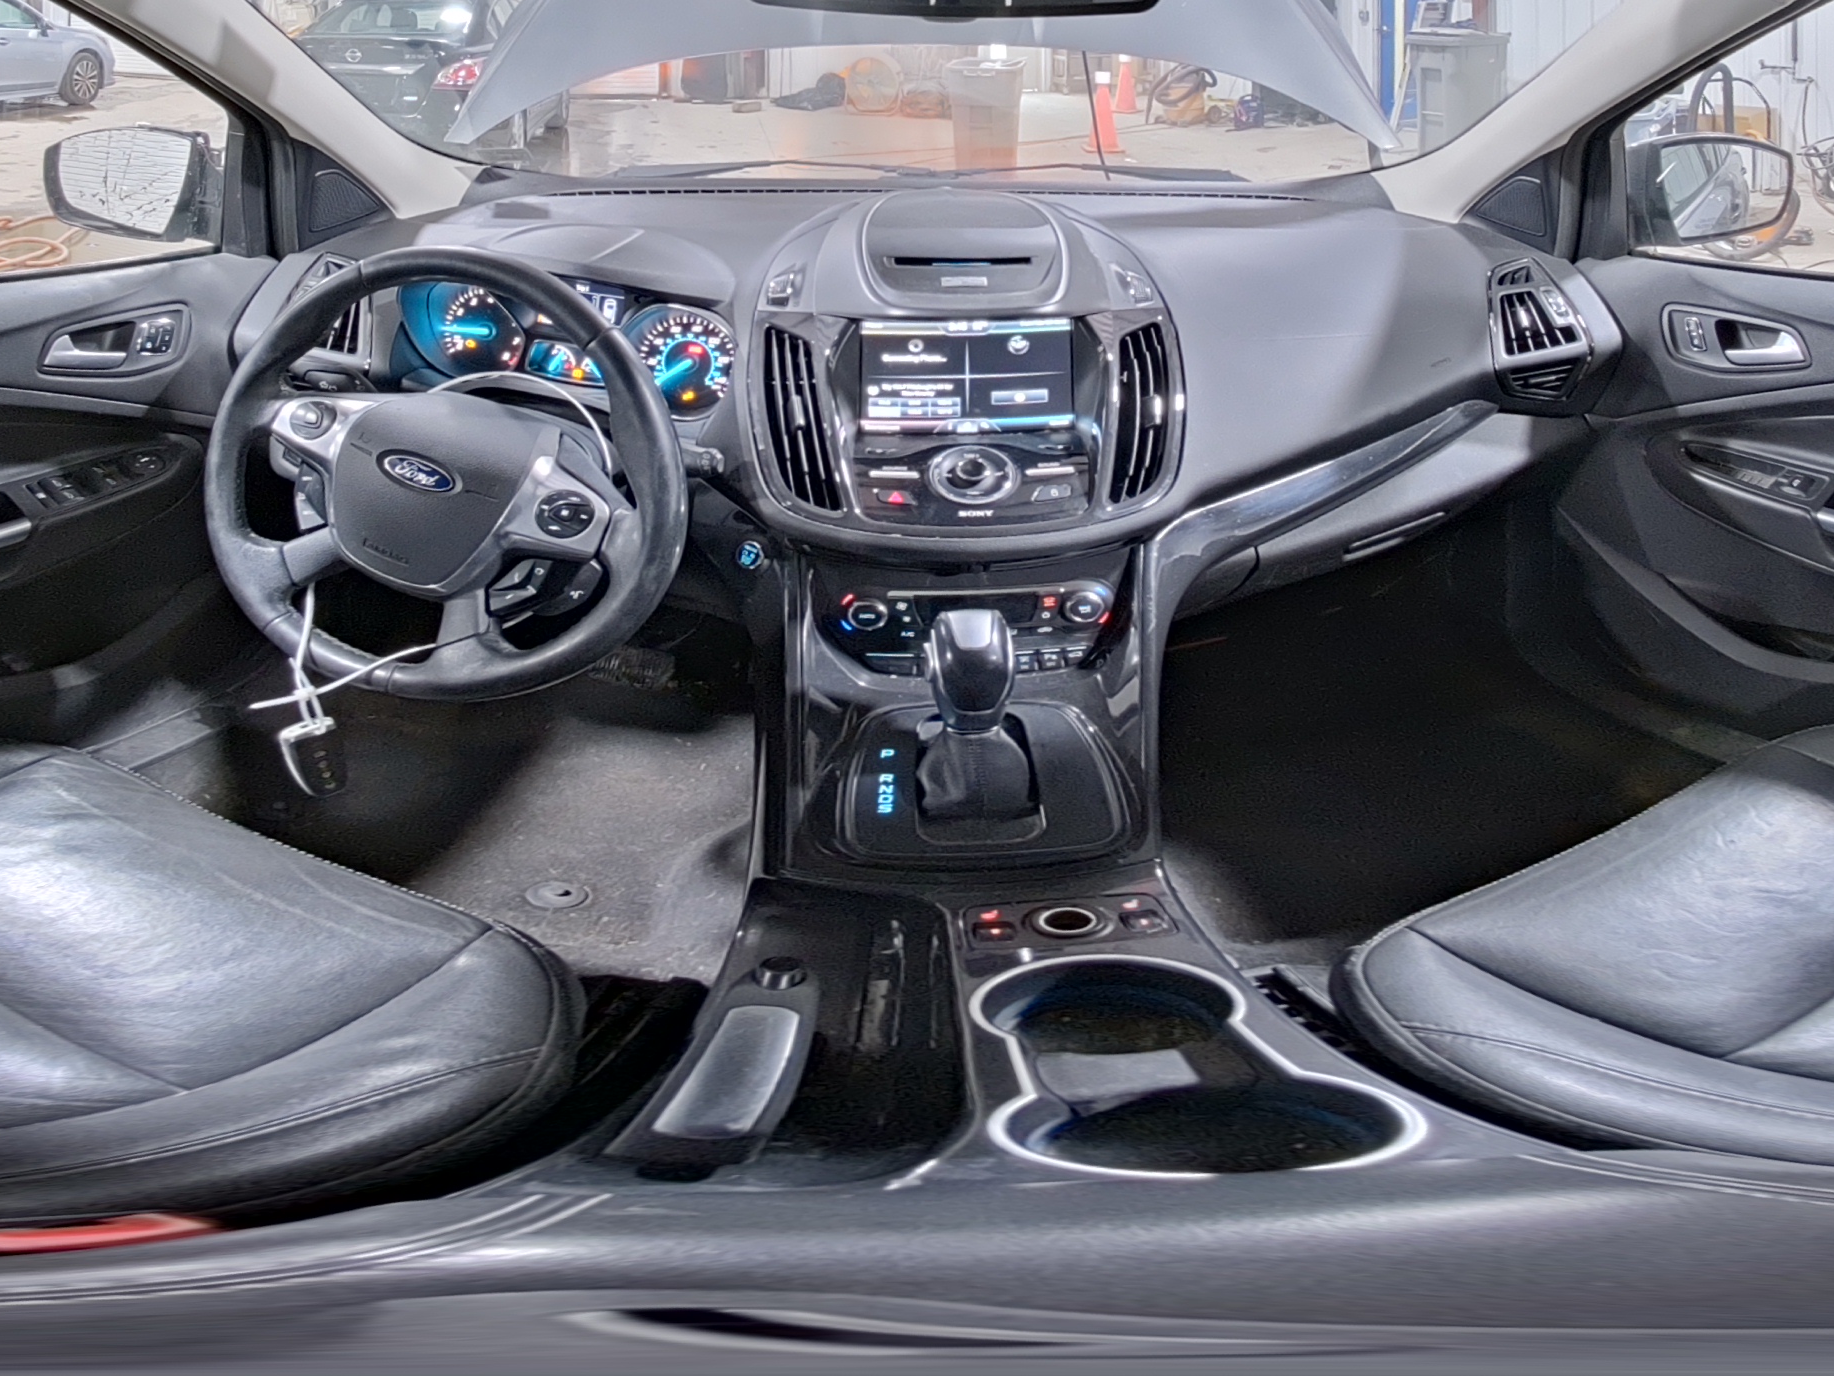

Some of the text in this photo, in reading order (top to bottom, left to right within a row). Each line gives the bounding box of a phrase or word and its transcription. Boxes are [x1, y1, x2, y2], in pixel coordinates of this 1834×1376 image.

[394, 459, 440, 487] Ford
[957, 509, 995, 518] SONY
[880, 749, 895, 759] P
[879, 773, 895, 784] R
[878, 784, 894, 794] N
[877, 794, 894, 804] D
[876, 803, 893, 813] S
